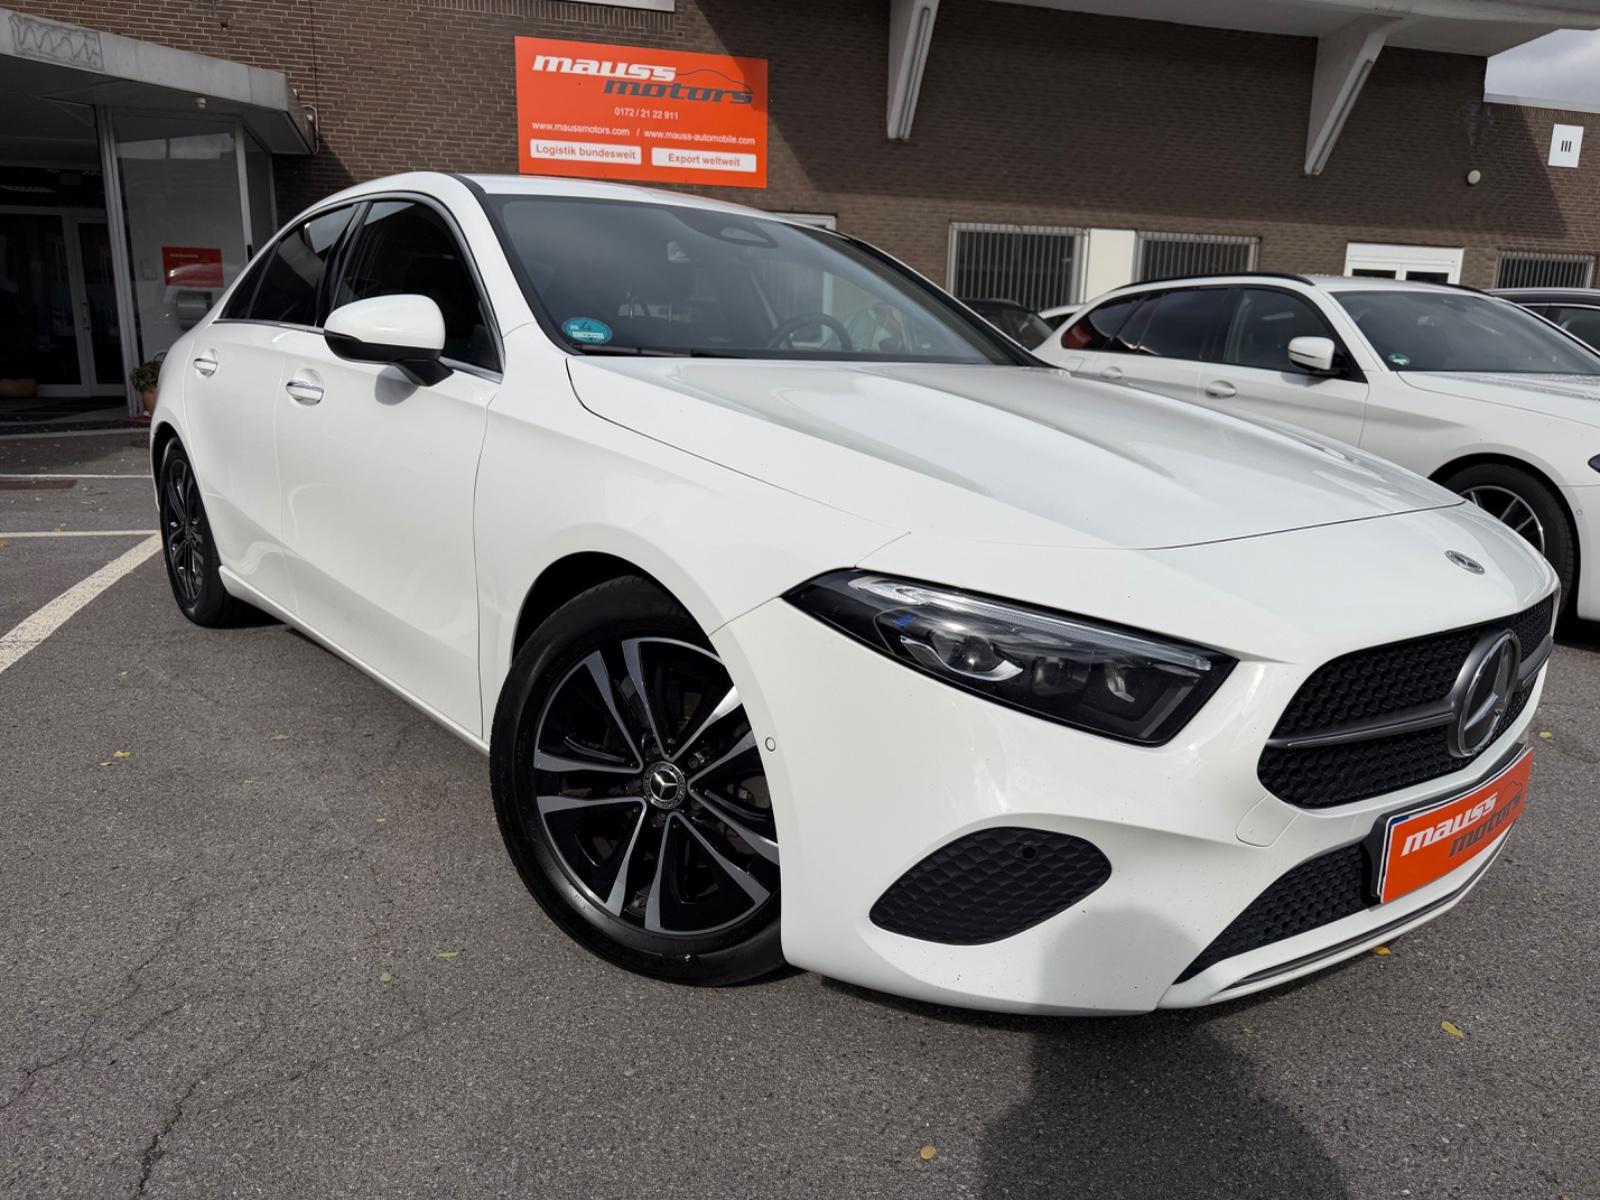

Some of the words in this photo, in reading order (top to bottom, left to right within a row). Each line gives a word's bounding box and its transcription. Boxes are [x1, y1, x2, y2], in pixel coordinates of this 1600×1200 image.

[532, 54, 676, 82] mauss
[603, 79, 754, 105] motors
[614, 106, 634, 117] 0172
[640, 109, 651, 118] 21
[652, 110, 663, 119] 22
[664, 111, 679, 120] 911
[531, 121, 629, 136] www.maussmotors.com
[643, 129, 755, 145] www.mauss-automobile.com
[536, 143, 577, 156] Logistik
[578, 146, 637, 160] bundesweit
[668, 152, 700, 165] Export
[702, 156, 741, 167] weltweit
[1401, 792, 1498, 856] mauss
